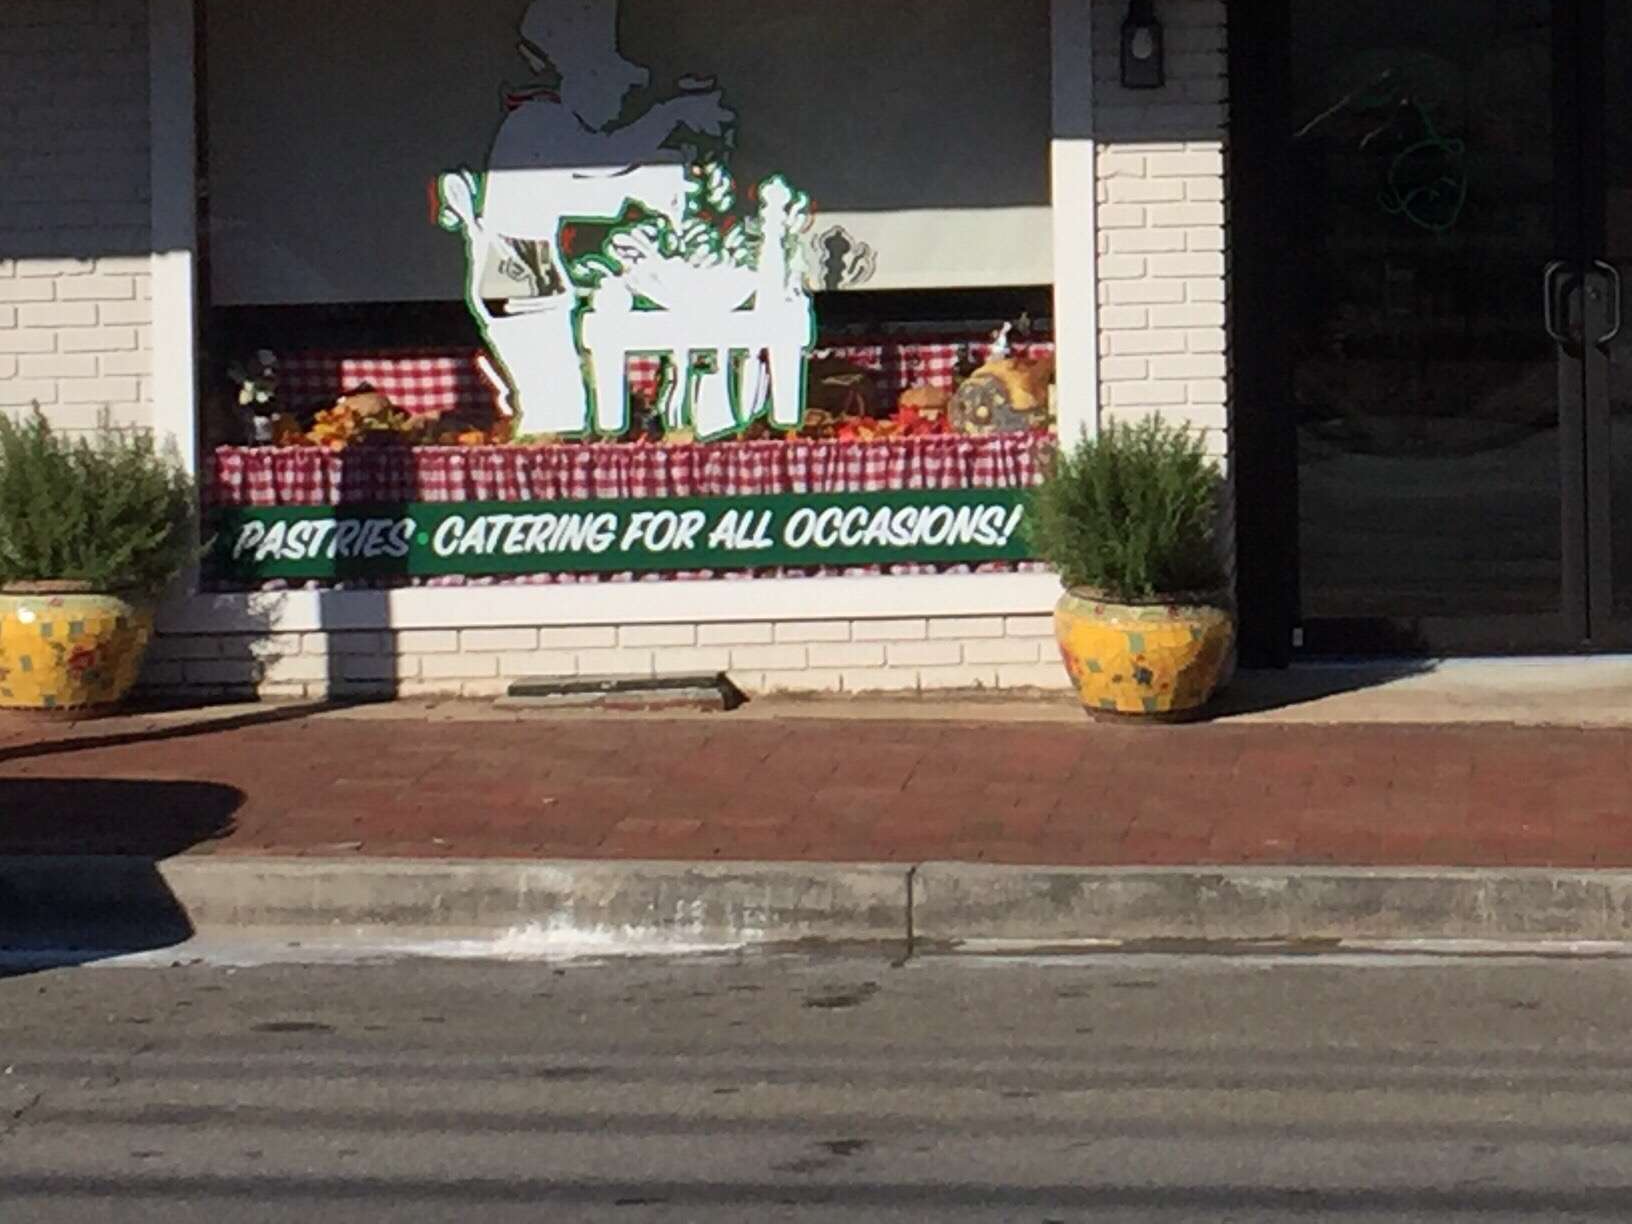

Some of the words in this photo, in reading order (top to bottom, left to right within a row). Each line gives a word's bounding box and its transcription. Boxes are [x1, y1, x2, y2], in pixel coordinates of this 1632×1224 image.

[232, 517, 417, 561] PASTRIES
[432, 512, 617, 557] CATERING
[620, 509, 705, 552] FOR
[707, 508, 774, 550] ALL
[783, 503, 1025, 549] OCCASIONS!
